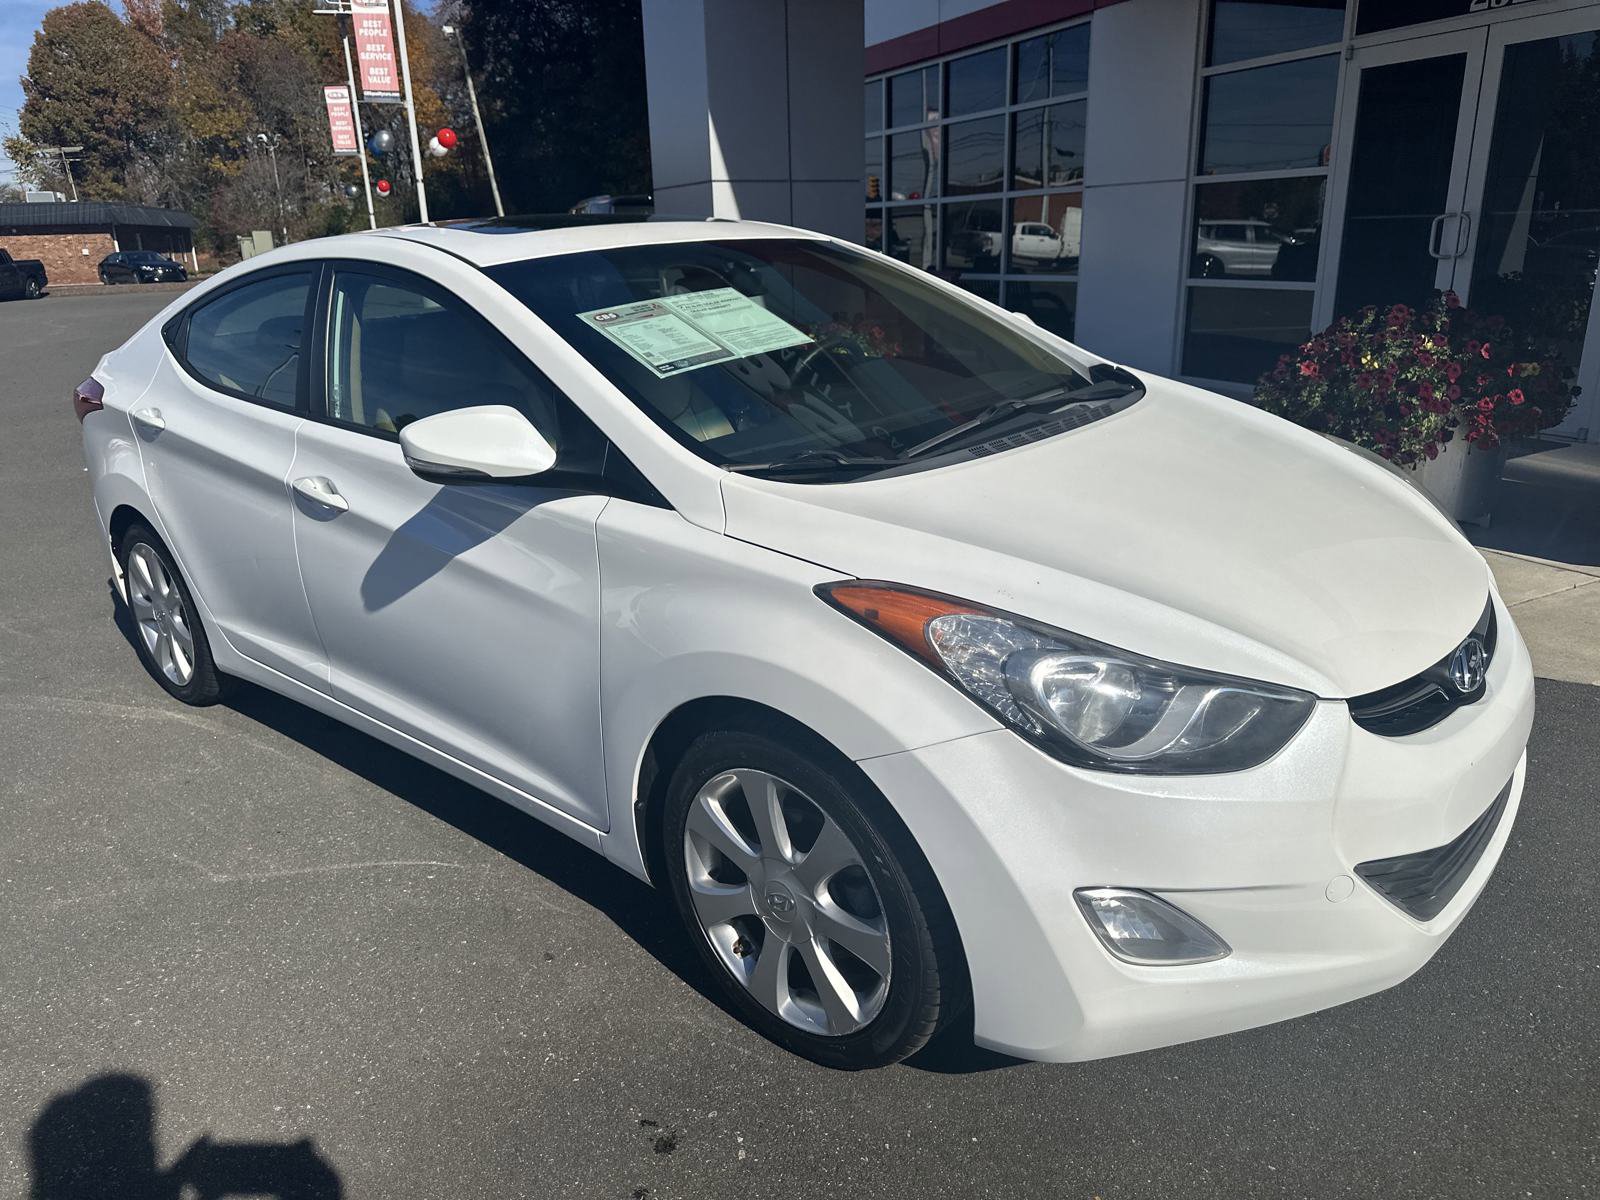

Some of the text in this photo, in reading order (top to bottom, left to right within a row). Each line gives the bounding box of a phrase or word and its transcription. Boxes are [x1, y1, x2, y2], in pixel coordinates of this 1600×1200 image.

[363, 20, 382, 28] BEST
[359, 28, 388, 37] PEOPLE
[366, 44, 385, 52] BEST
[360, 52, 392, 60] SERVICE
[369, 67, 389, 75] BEST
[368, 76, 392, 84] VALUE
